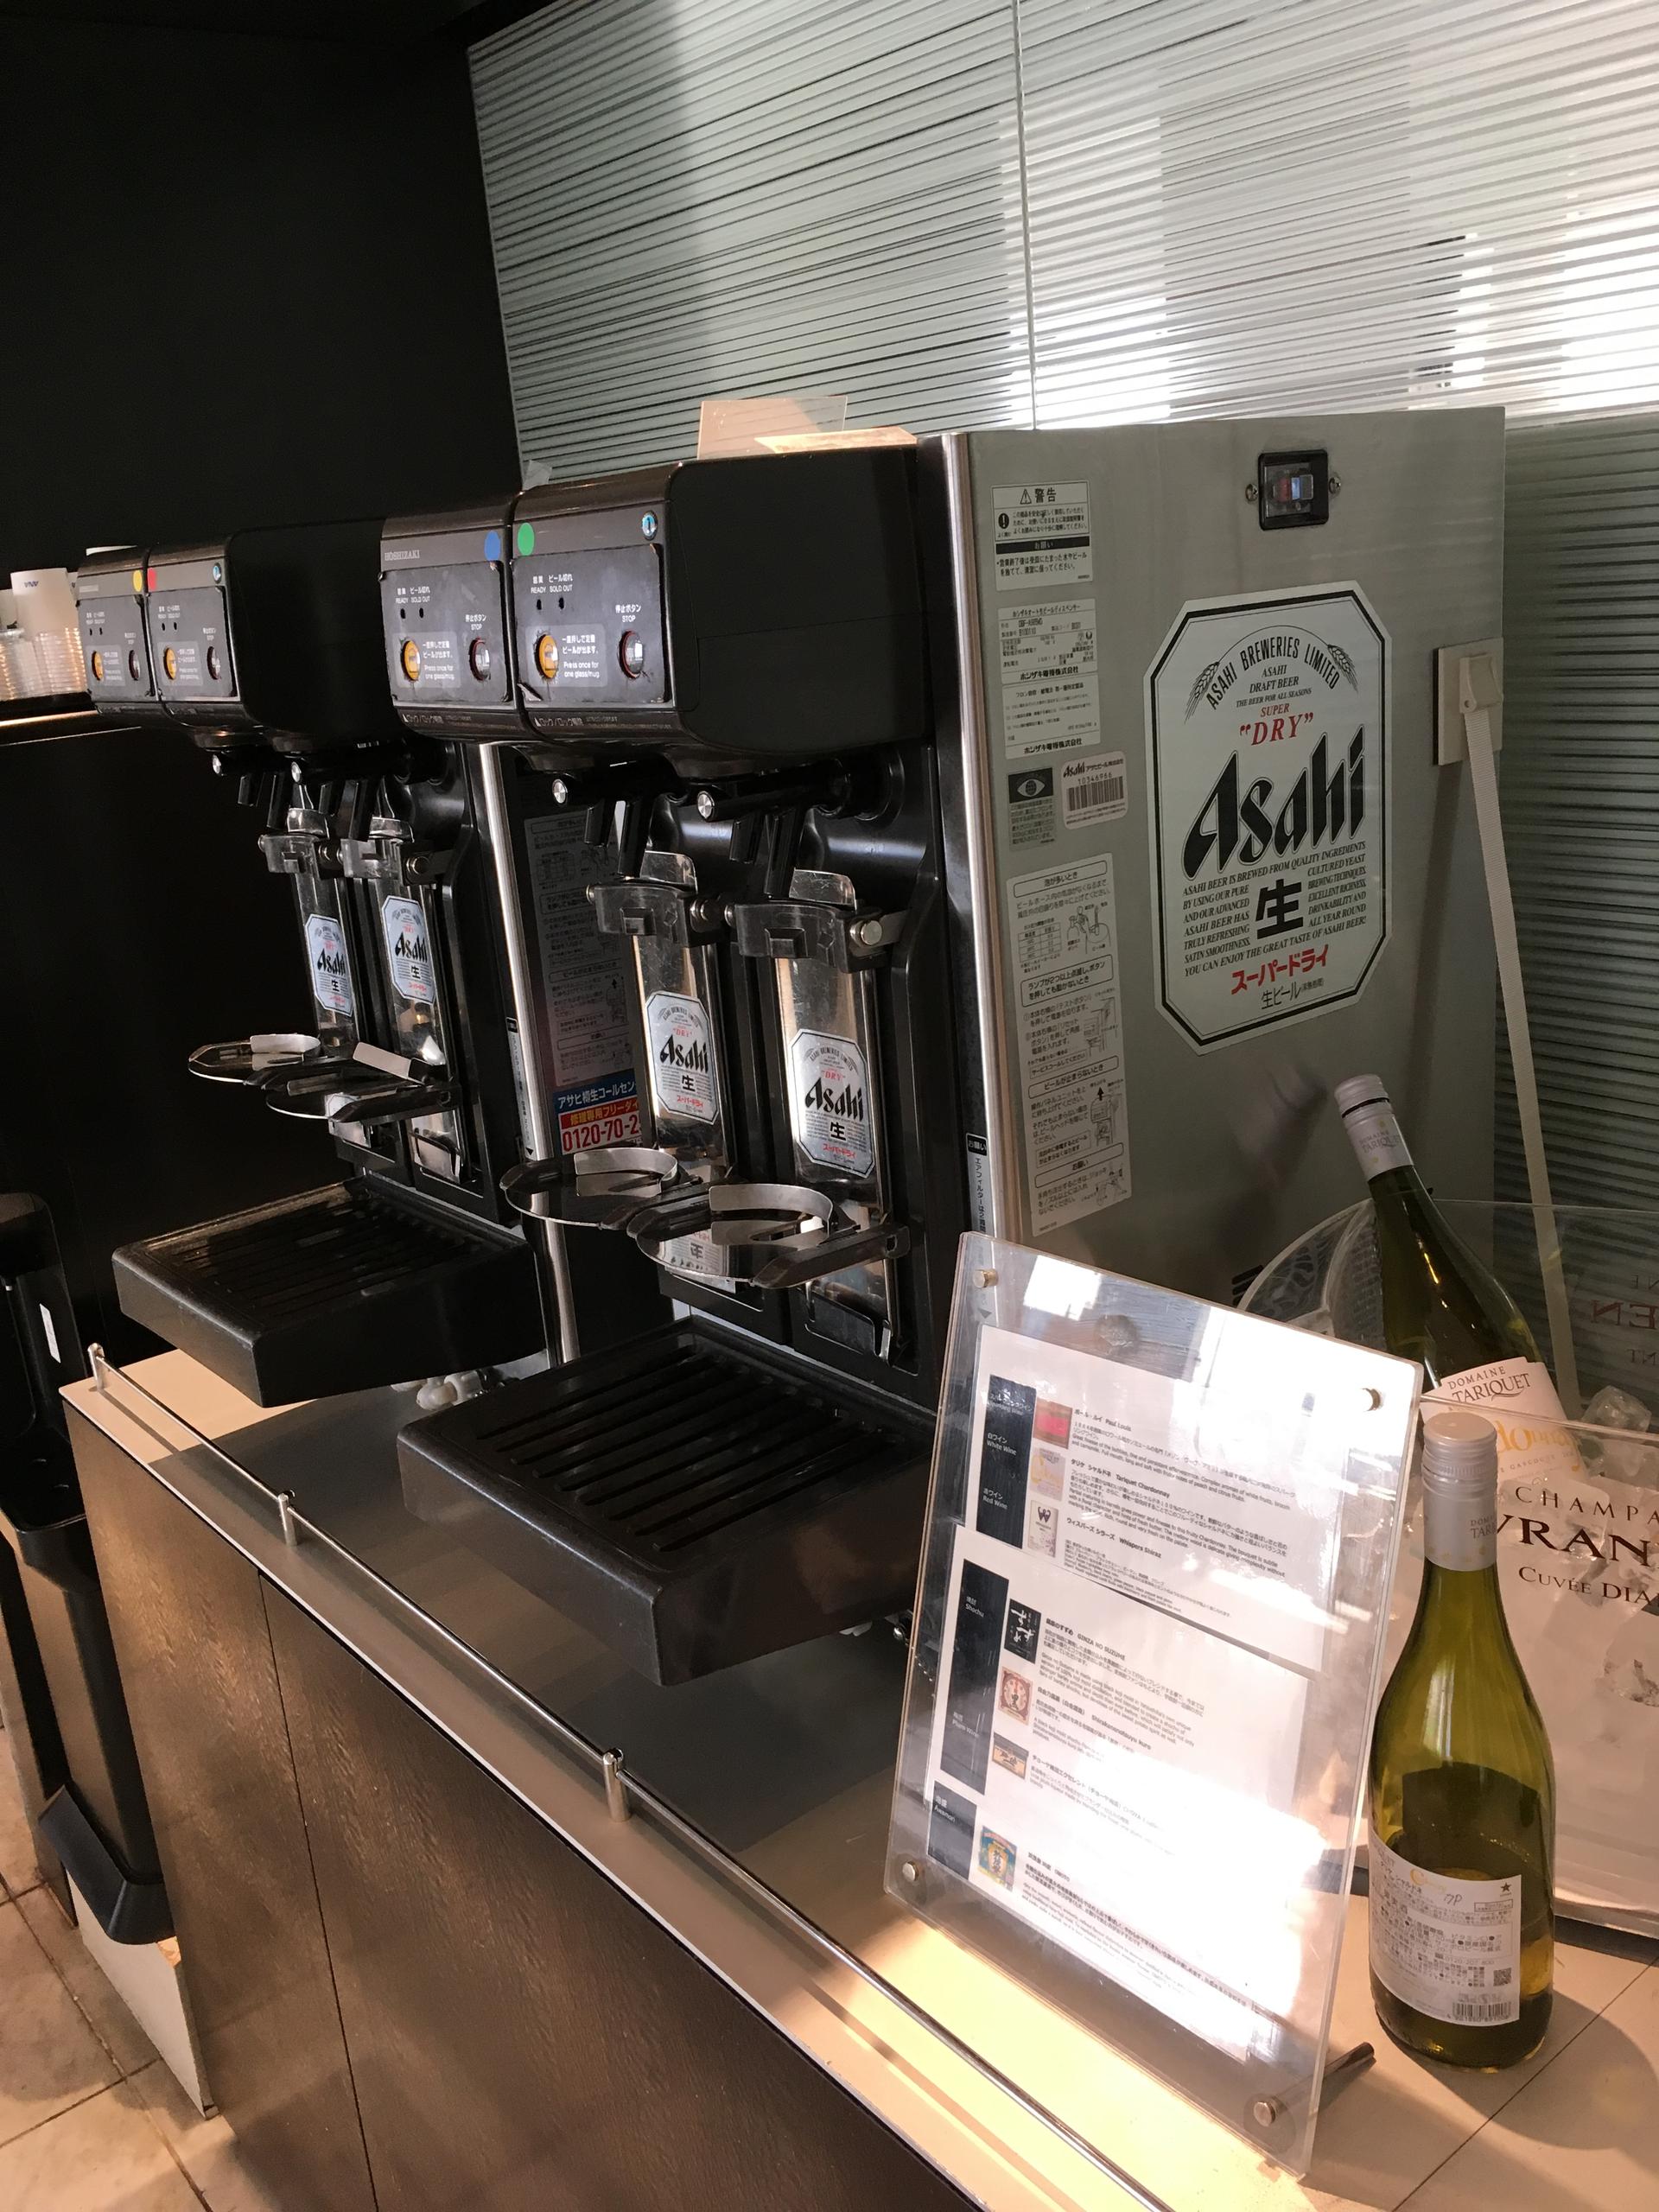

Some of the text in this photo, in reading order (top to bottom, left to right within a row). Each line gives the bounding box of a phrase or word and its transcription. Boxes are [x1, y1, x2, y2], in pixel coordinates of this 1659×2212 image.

[1034, 488, 1057, 503] 警告
[385, 550, 420, 561] HOSHIZAKI
[549, 574, 572, 582] ビール切れ
[615, 605, 641, 613] 停止ボタン
[1205, 636, 1340, 710] ASAHI BREWERIES LIMITED
[1262, 664, 1287, 677] ASAHI
[1249, 697, 1263, 706] BEER
[1264, 694, 1275, 703] FOR
[1277, 692, 1287, 701] ALL
[1288, 688, 1312, 698] SEASONS
[1250, 677, 1299, 694] DRAFT BEER
[1261, 703, 1289, 717] SUPER
[1064, 762, 1085, 778] Asahi
[1183, 724, 1365, 880] Asahi
[1183, 840, 1365, 896] ASAHI BEER IS BREWED FROM QUALITY INGREDIENTS
[1307, 853, 1365, 876] CULTURED YEAST
[1308, 865, 1365, 888] BREWING TECHNIQUES
[1183, 884, 1249, 909] BY USING OUR PURE
[1308, 878, 1366, 902] EXCELLENT RICHNESS
[1183, 897, 1249, 924] AND OUR ADVANCED
[1255, 873, 1303, 940] 生
[1308, 891, 1365, 915] DRINKABILITY AND
[1308, 903, 1365, 927] ALL YEAR ROUND
[1184, 910, 1249, 937] ASAHI BEER HAS
[395, 931, 427, 963] Asahi
[1184, 923, 1249, 950] TRULY REFRESHING
[1184, 915, 1366, 977] YOU CAN ENJOY THE GREAT TASTE OF ASAHI BEER!
[317, 948, 346, 976] Asahi
[1184, 936, 1250, 964] SATIN SMOOTHNESS
[411, 965, 421, 979] 生
[1230, 943, 1328, 995] スーパードライ
[332, 980, 340, 992] 生
[660, 1034, 709, 1073] Asahi
[682, 1075, 696, 1092] 生
[804, 1077, 863, 1122] Asahi
[830, 1122, 847, 1141] 生
[1448, 1365, 1506, 1390] DOMAINE
[1452, 1373, 1531, 1403] TARIQUET
[987, 1440, 1017, 1456] White Wine
[1116, 1473, 1137, 1487] Tariquet
[1137, 1481, 1169, 1499] Chardonnay
[982, 1495, 1007, 1510] Red Wine
[1119, 1537, 1143, 1552] Whispers
[1144, 1546, 1161, 1559] Shiraz
[965, 1603, 984, 1618] Shochu
[1076, 1633, 1126, 1661] GINZA NO SUZUME
